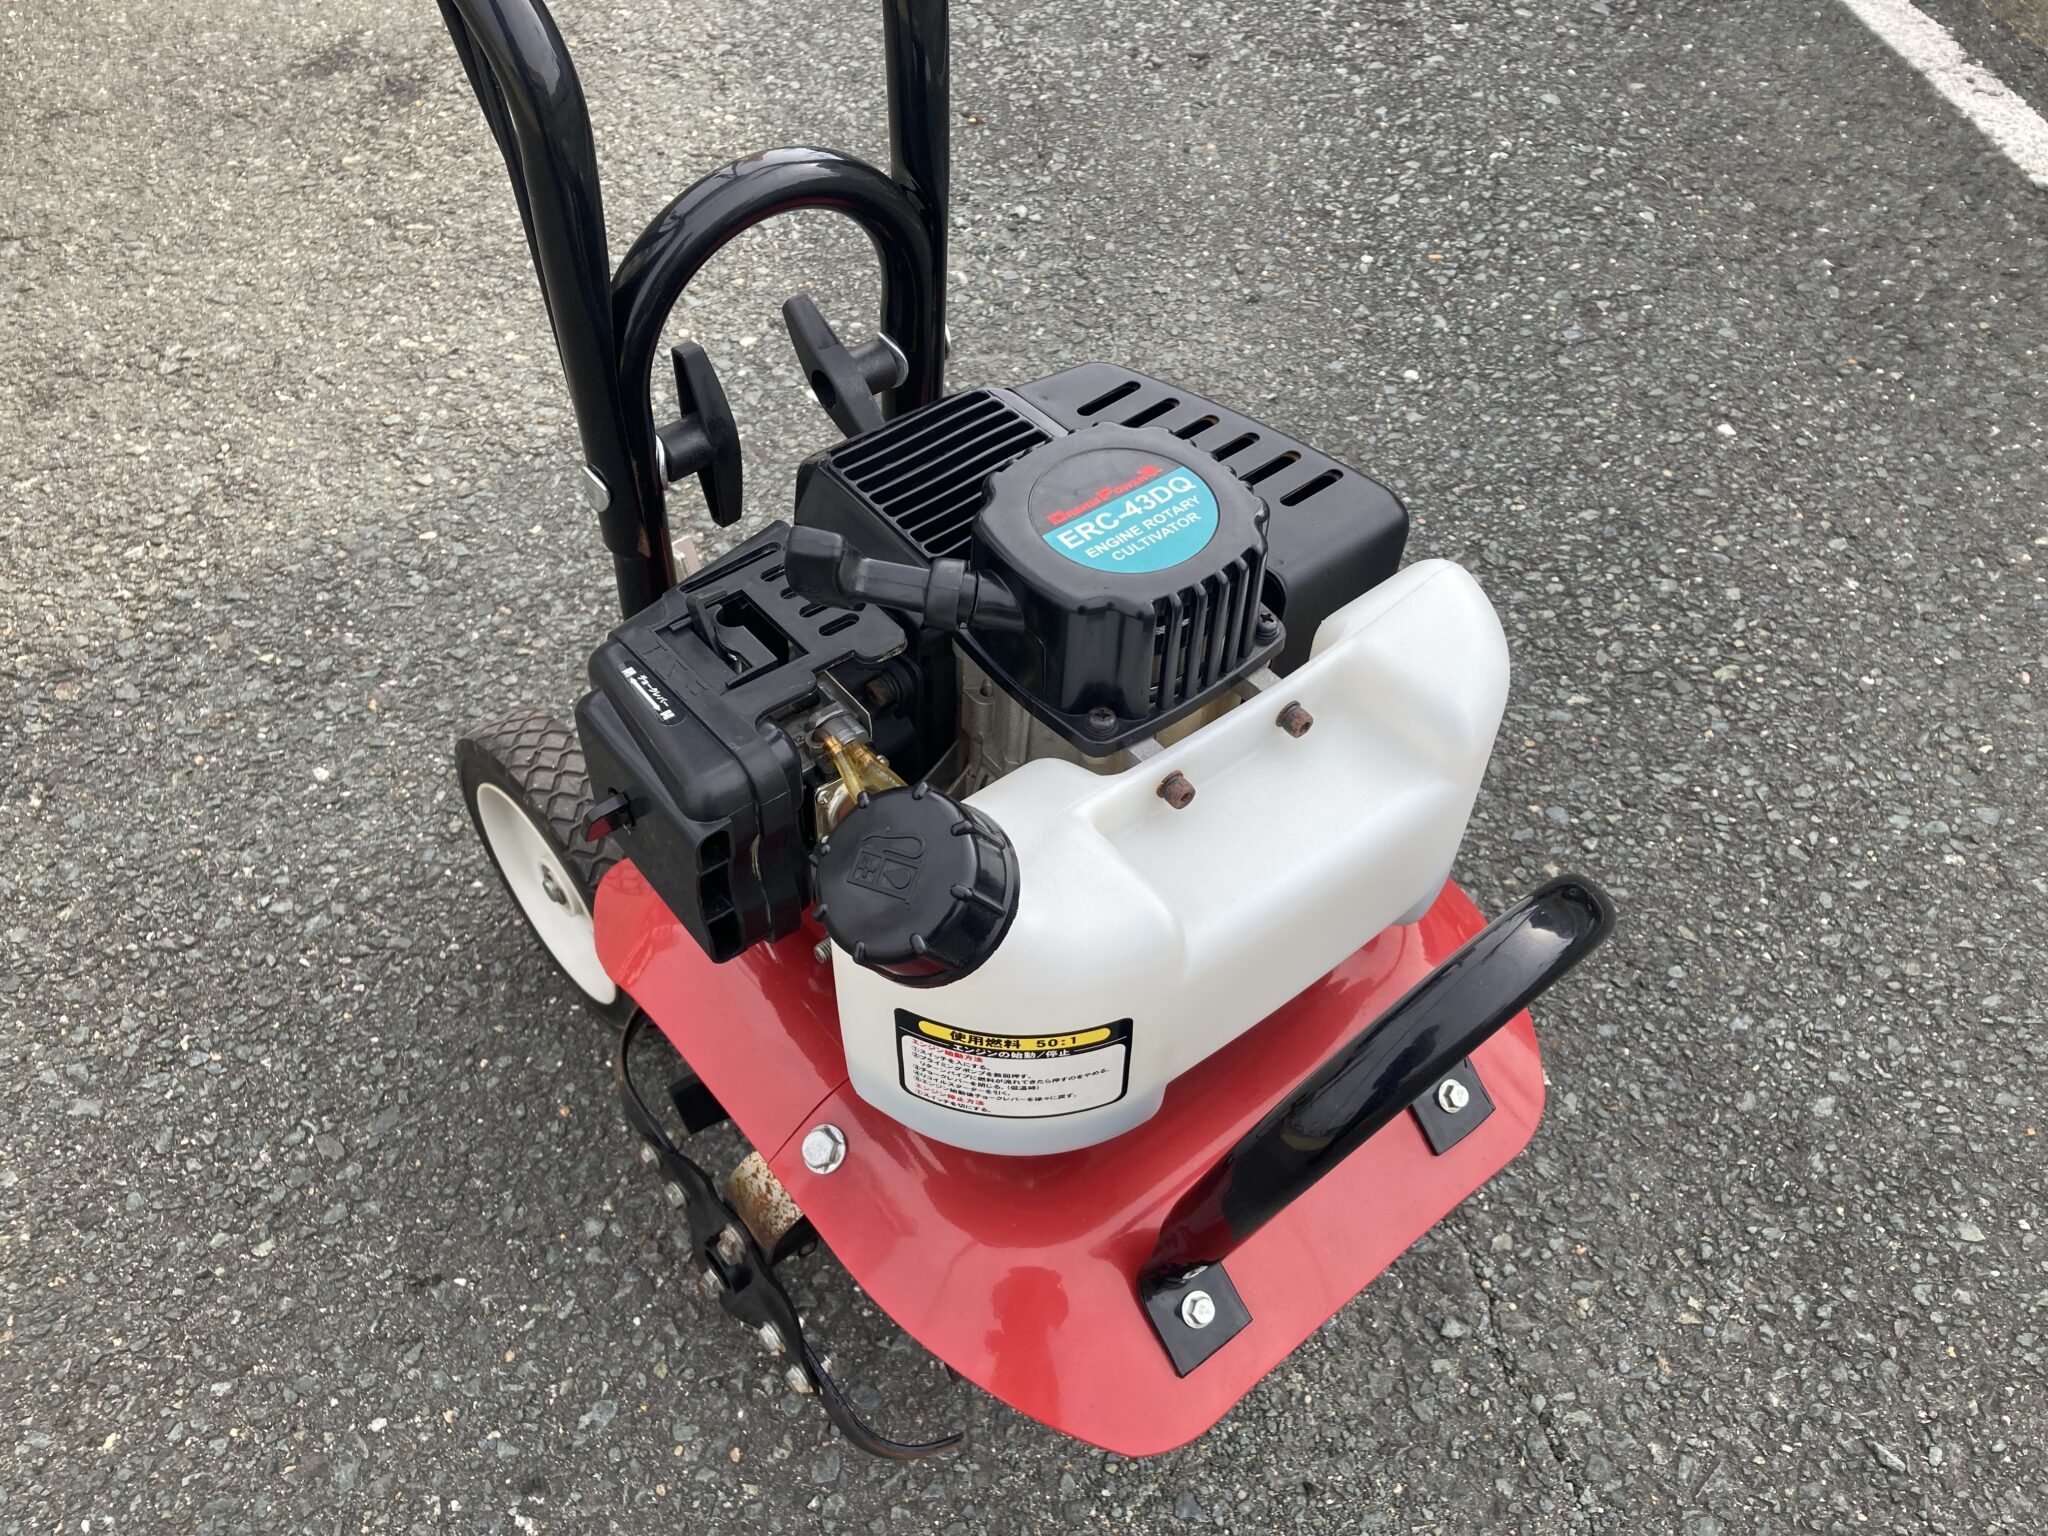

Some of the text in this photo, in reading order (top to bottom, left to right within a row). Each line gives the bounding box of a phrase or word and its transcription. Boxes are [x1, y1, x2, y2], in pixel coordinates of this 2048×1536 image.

[1056, 476, 1196, 549] ERC-43DQ
[1084, 495, 1201, 558] ENGINE ROTARY
[1111, 512, 1202, 561] CULTIVATOR
[911, 1039, 983, 1063] エンジン始動方法
[949, 1030, 1021, 1050] 使用燃料
[915, 1083, 985, 1106] エンジン停止方法
